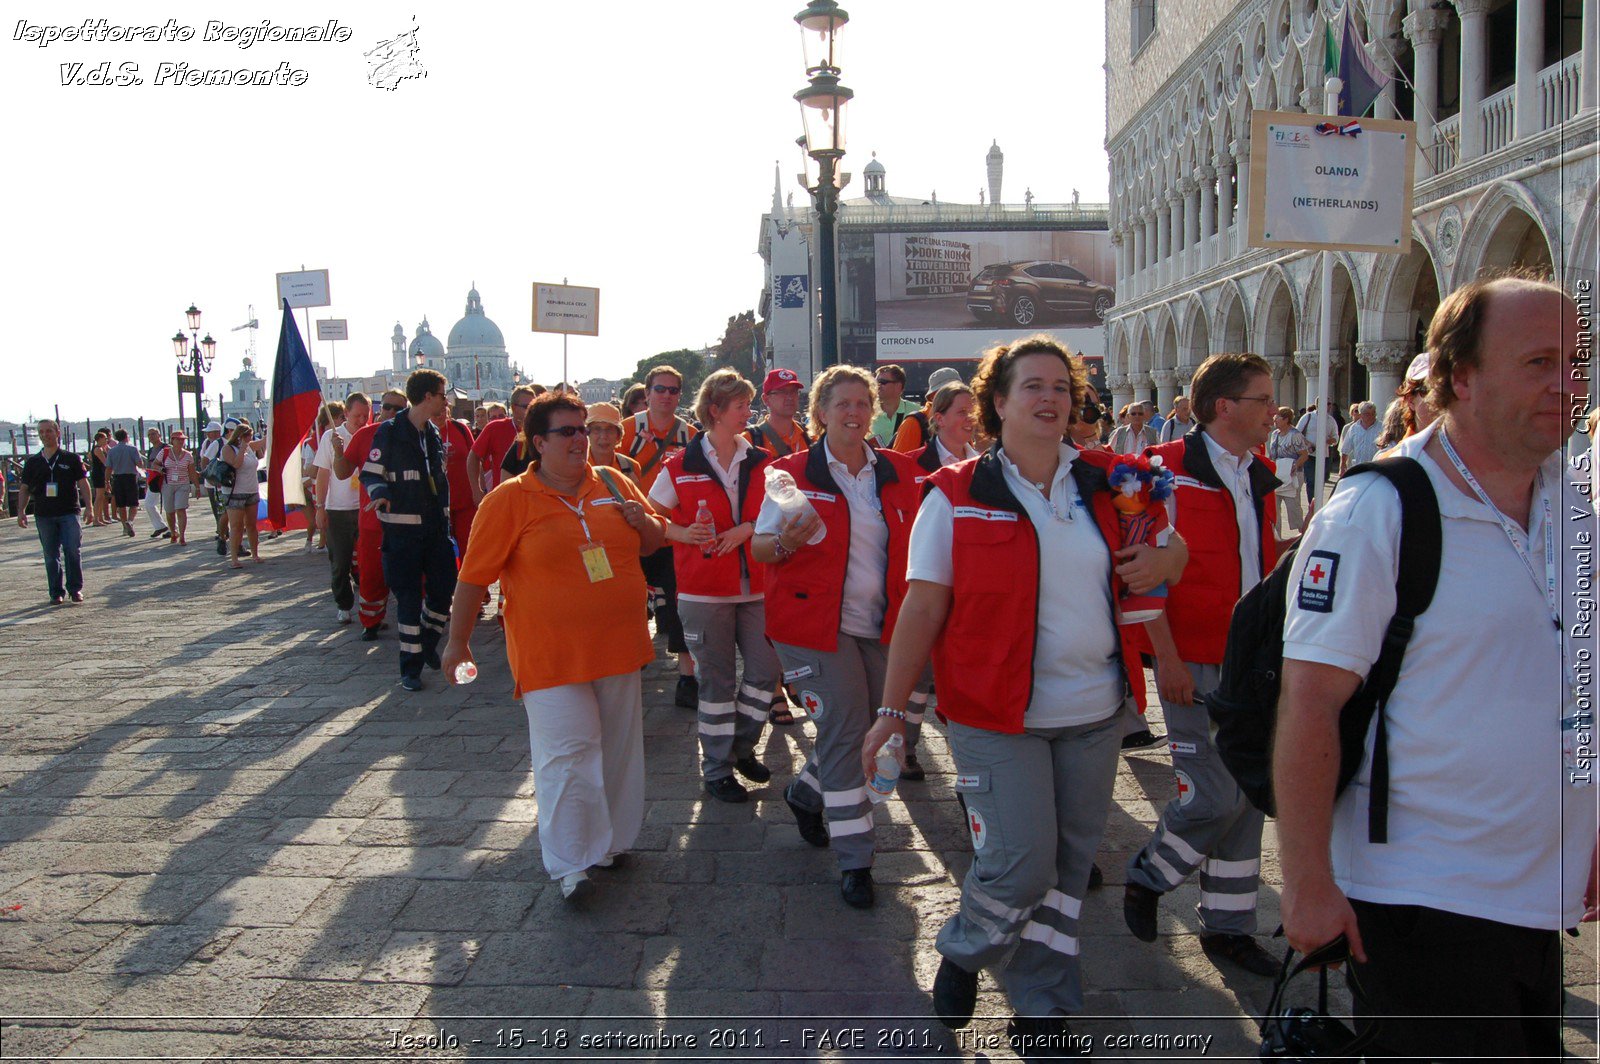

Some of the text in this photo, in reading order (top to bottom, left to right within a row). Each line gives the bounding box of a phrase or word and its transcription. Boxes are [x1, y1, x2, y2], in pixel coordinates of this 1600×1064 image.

[1315, 165, 1359, 177] OLANDA
[1292, 197, 1379, 212] (NETHERLANDS)
[919, 247, 961, 260] DOVE NON
[918, 336, 935, 345] DS4
